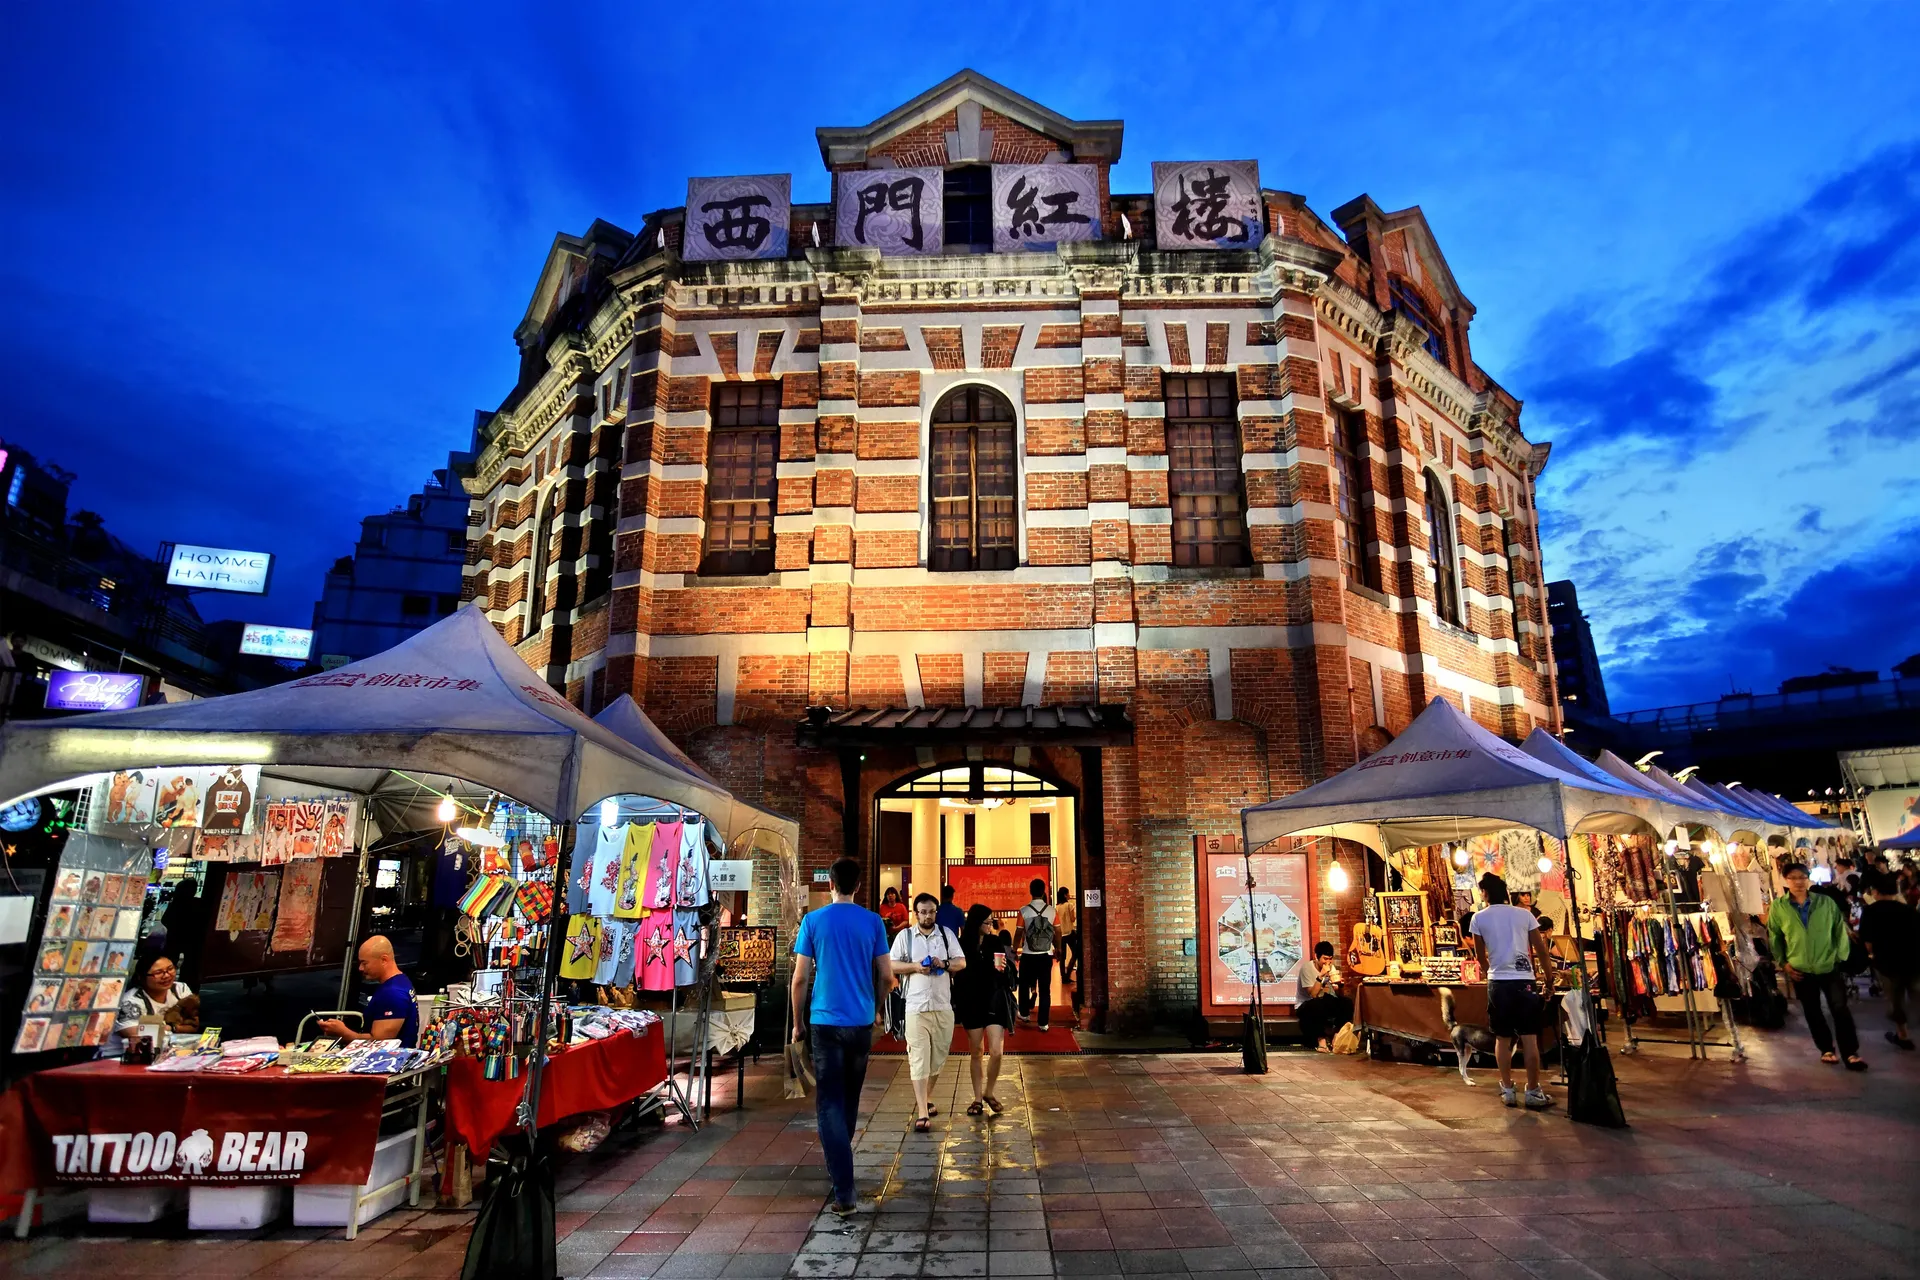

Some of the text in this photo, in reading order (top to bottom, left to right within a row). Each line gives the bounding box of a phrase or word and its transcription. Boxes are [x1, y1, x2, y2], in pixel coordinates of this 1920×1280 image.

[179, 551, 264, 569] HOMME
[175, 569, 231, 582] HAIR
[52, 1131, 308, 1174] TATTOO BEAR
